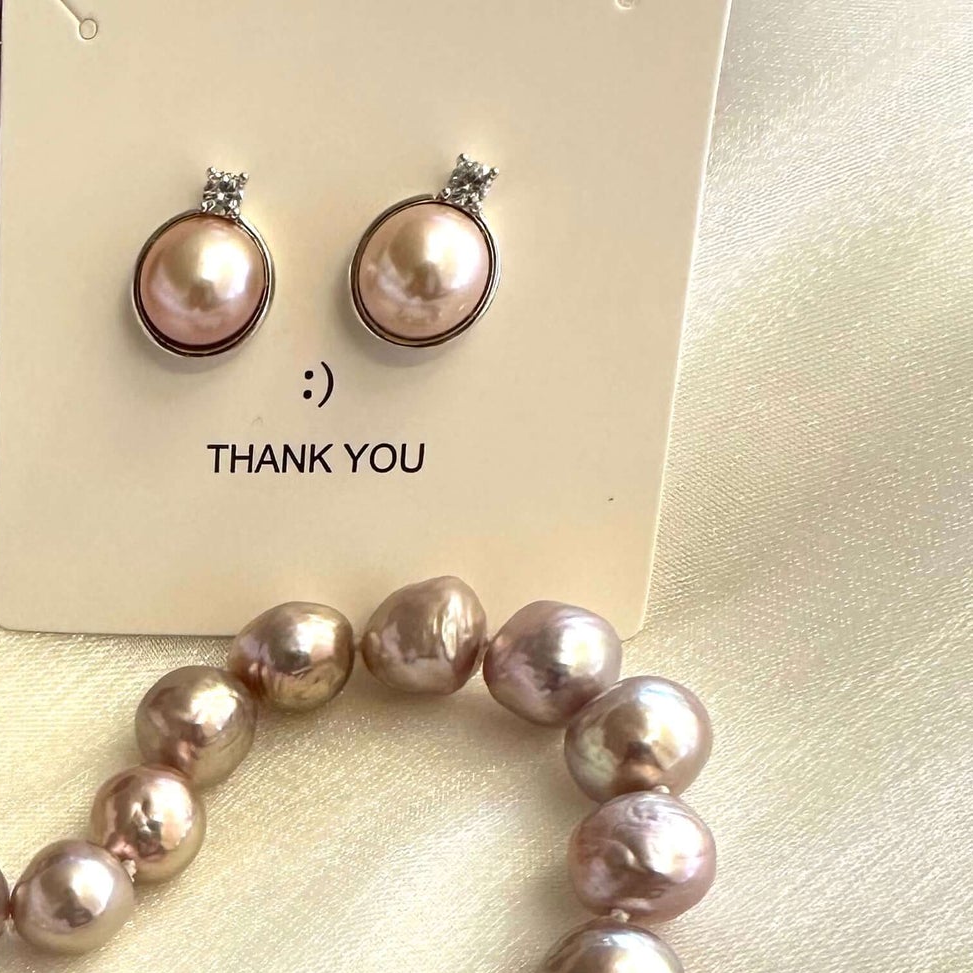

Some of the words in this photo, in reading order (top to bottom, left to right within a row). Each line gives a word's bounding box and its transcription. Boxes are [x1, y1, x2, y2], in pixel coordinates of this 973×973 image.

[302, 361, 334, 408] :)
[206, 443, 334, 474] THANK
[343, 442, 426, 474] YOU
